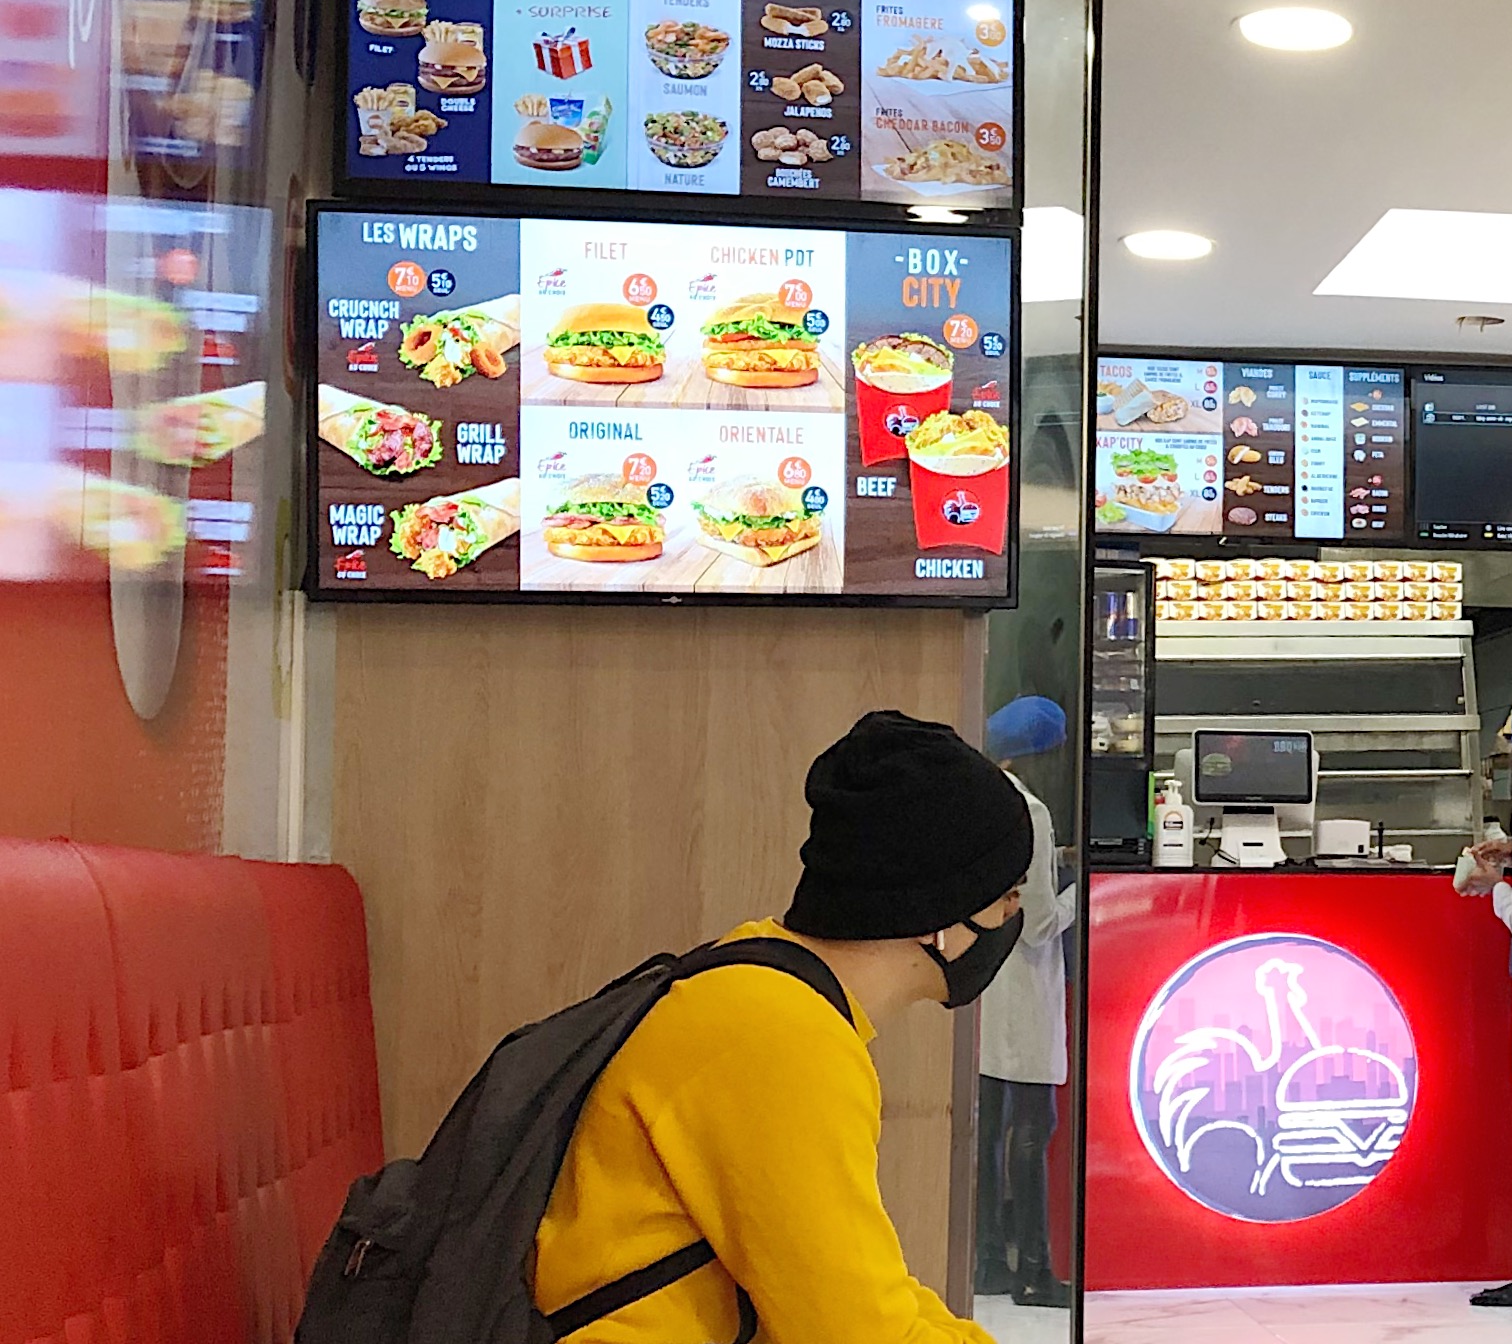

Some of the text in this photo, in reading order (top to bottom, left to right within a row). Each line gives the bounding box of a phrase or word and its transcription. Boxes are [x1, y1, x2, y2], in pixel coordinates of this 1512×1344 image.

[528, 6, 613, 19] SURPRISE
[876, 5, 904, 15] FRITES
[368, 44, 394, 54] FILET
[763, 37, 826, 51] MOZZA STICKS
[662, 83, 708, 97] SAUMON
[875, 107, 903, 117] FRITES
[876, 117, 970, 134] CHEDDAR BACON
[663, 173, 705, 187] NATURE
[362, 221, 478, 252] LES WRAPS
[584, 241, 628, 260] FILET
[710, 245, 815, 268] CHICKEN PDT
[394, 266, 419, 286] 7€10
[901, 276, 962, 309] CITY
[328, 298, 400, 319] CRUCNCH
[339, 319, 390, 339] WRAP
[1100, 364, 1133, 378] TACOS
[1308, 370, 1332, 380] SAUCE
[456, 423, 506, 444] GRILL
[568, 421, 644, 441] ORIGINAL
[718, 425, 804, 444] ORIENTALE
[456, 444, 507, 465] WRAP
[856, 476, 896, 497] BEEF
[329, 504, 385, 525] MAGIC
[332, 525, 383, 546] WRAP
[915, 558, 984, 579] CHICKEN
